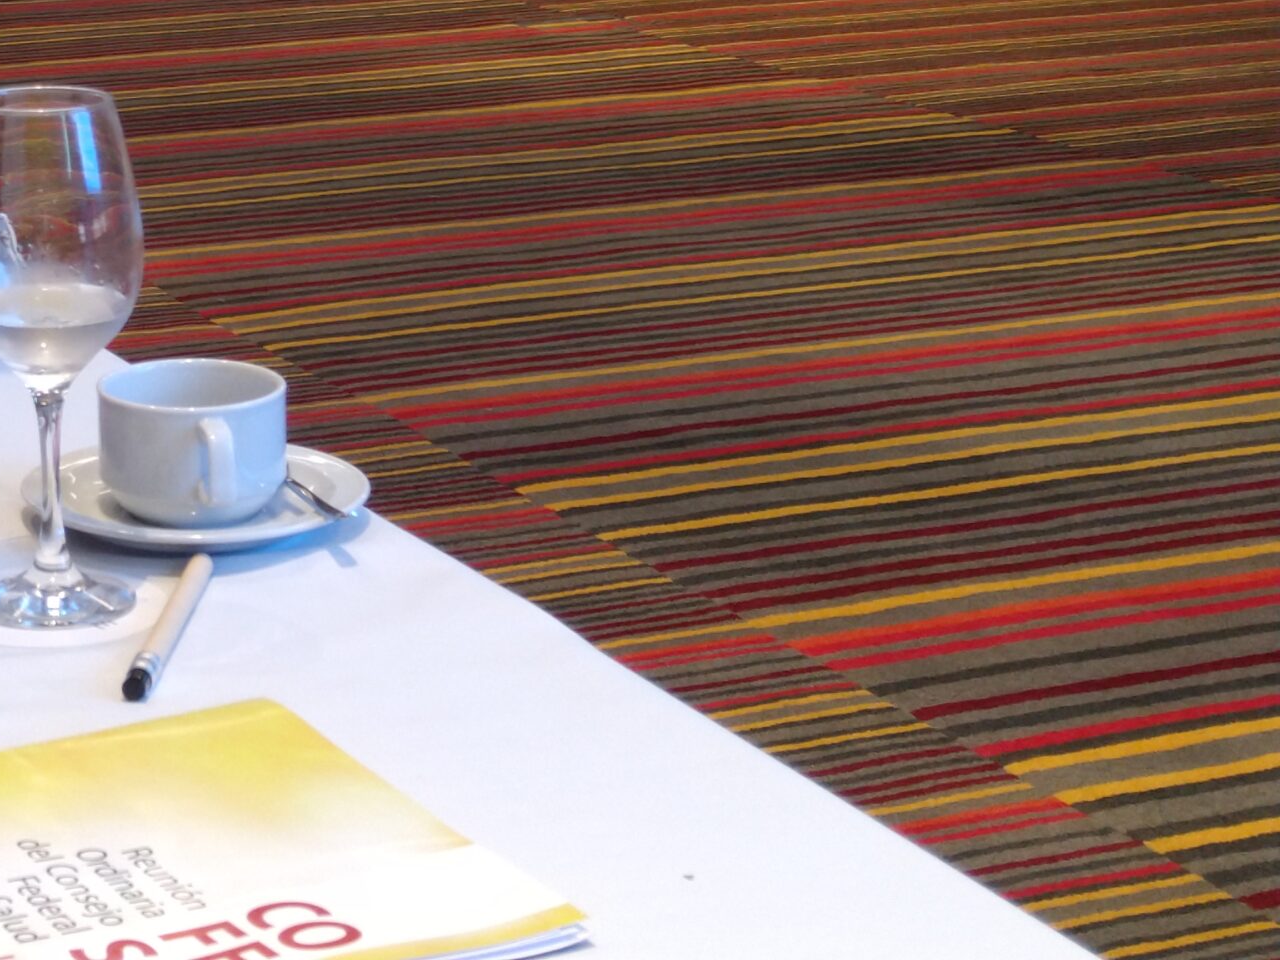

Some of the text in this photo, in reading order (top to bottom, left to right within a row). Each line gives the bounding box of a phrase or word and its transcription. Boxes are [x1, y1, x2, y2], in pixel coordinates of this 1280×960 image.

[6, 874, 94, 936] Federal
[16, 838, 124, 928] del Consejo
[76, 847, 166, 920] Ordinaria
[121, 845, 207, 911] Reunión
[246, 901, 363, 951] CO
